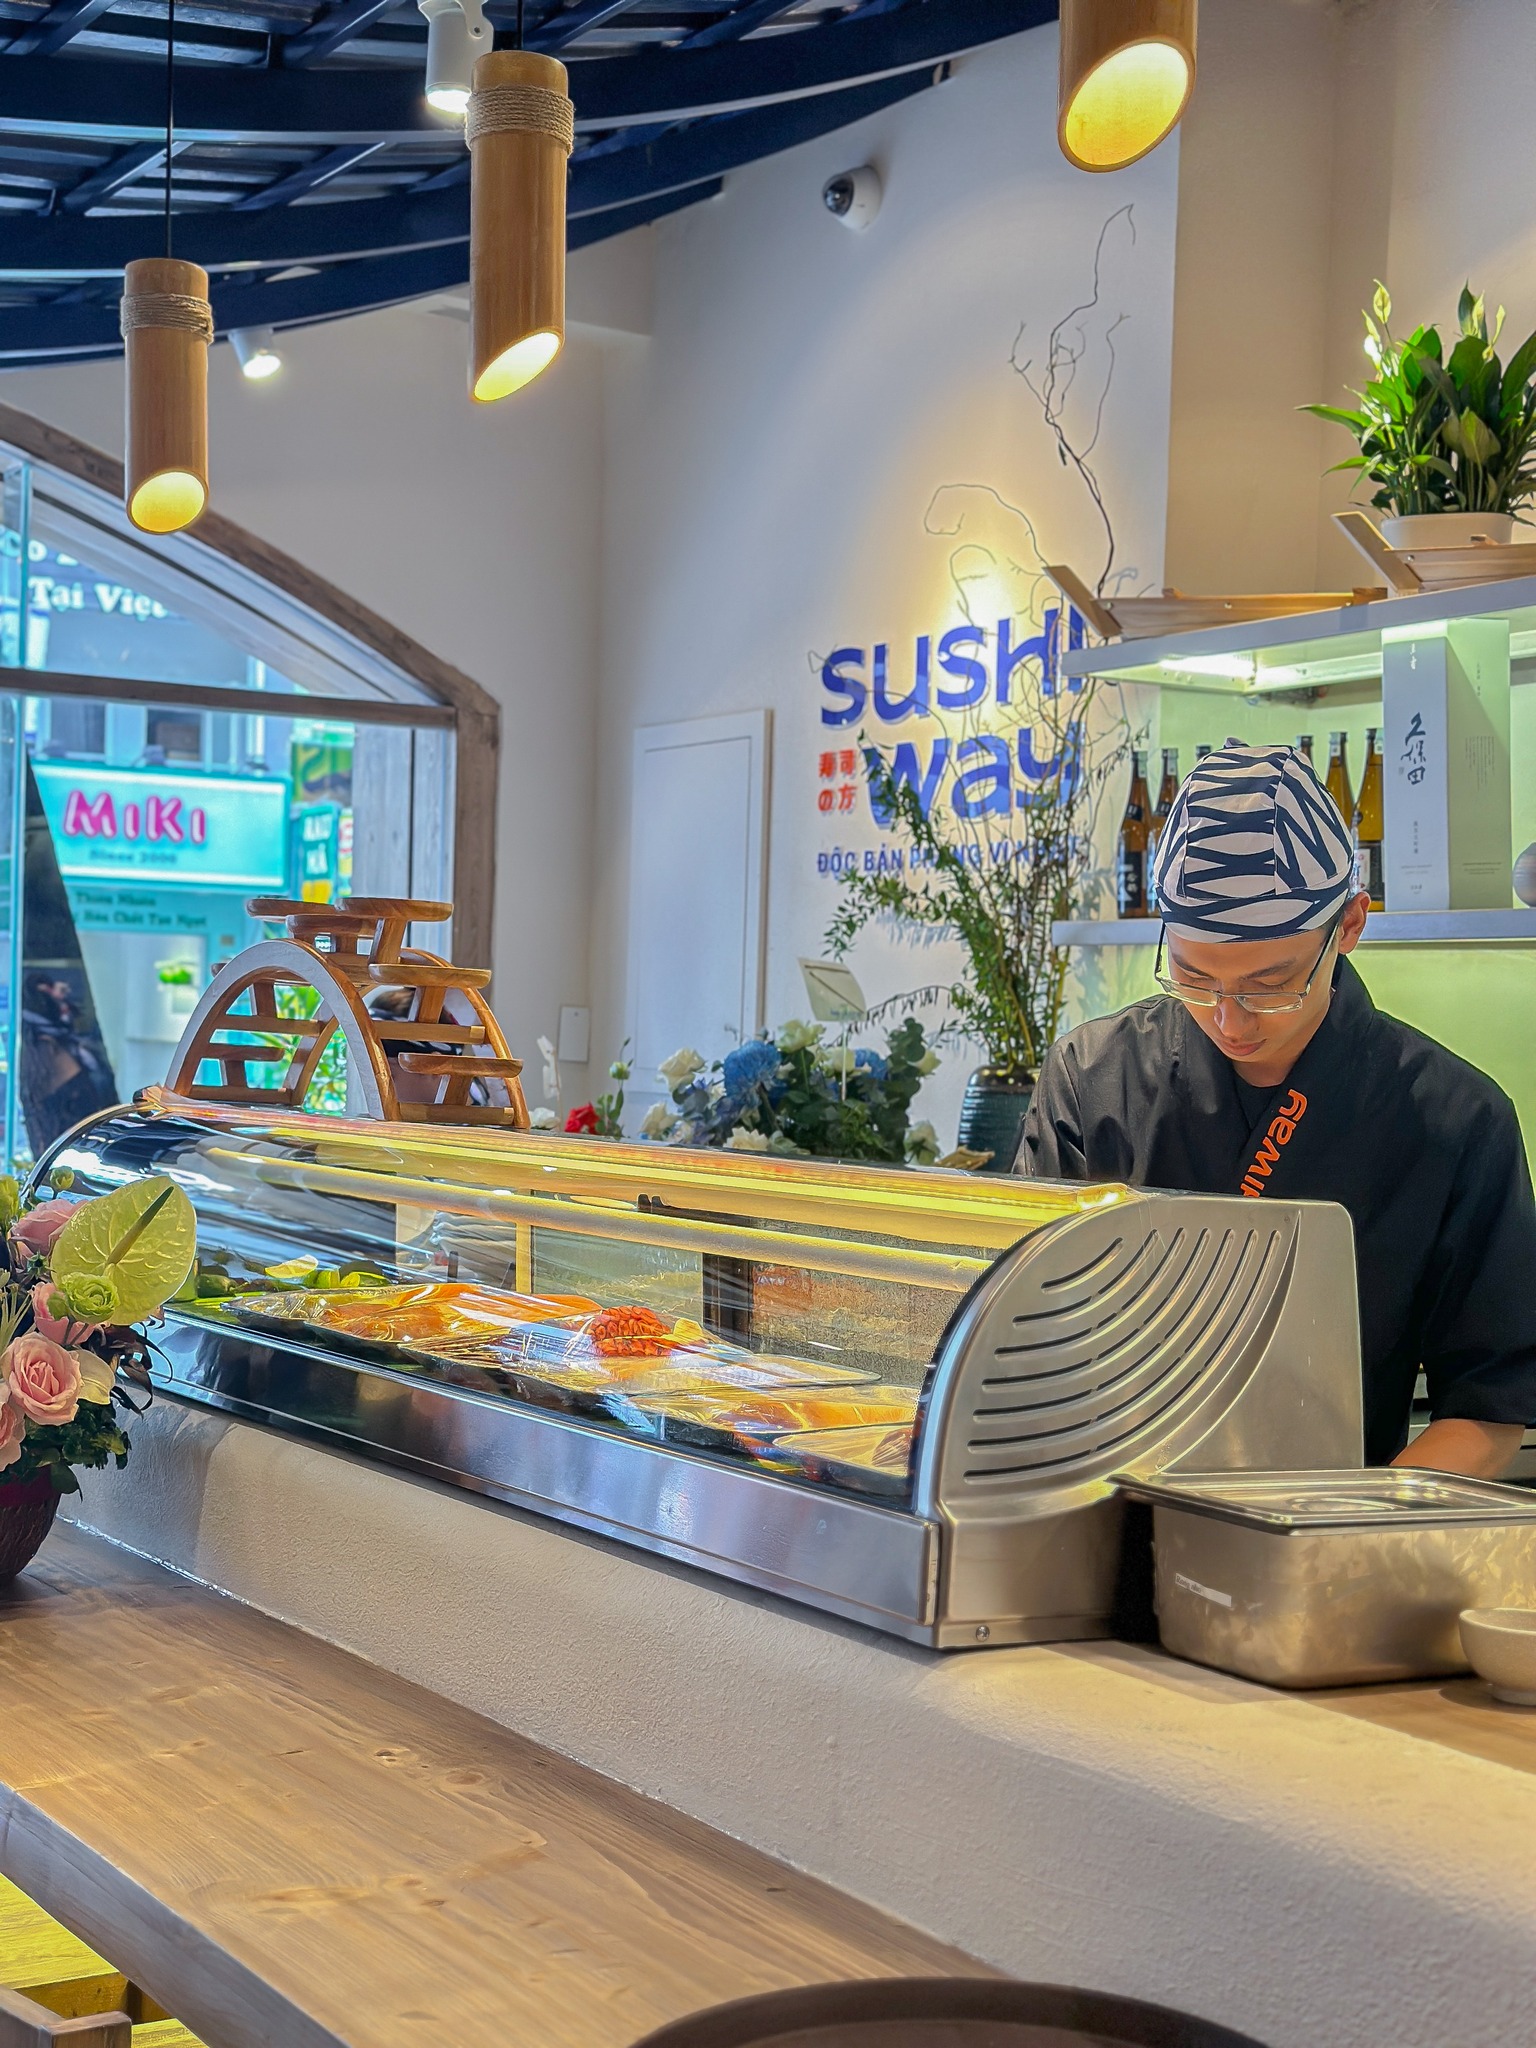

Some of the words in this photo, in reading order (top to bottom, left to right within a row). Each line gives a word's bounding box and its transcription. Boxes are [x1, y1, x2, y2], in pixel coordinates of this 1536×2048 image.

[820, 604, 1085, 729] sushi
[861, 721, 1086, 828] way
[1400, 712, 1426, 785] 久保田
[817, 846, 856, 880] ĐỘC
[863, 843, 903, 872] BẢN
[910, 843, 982, 870] PHNG
